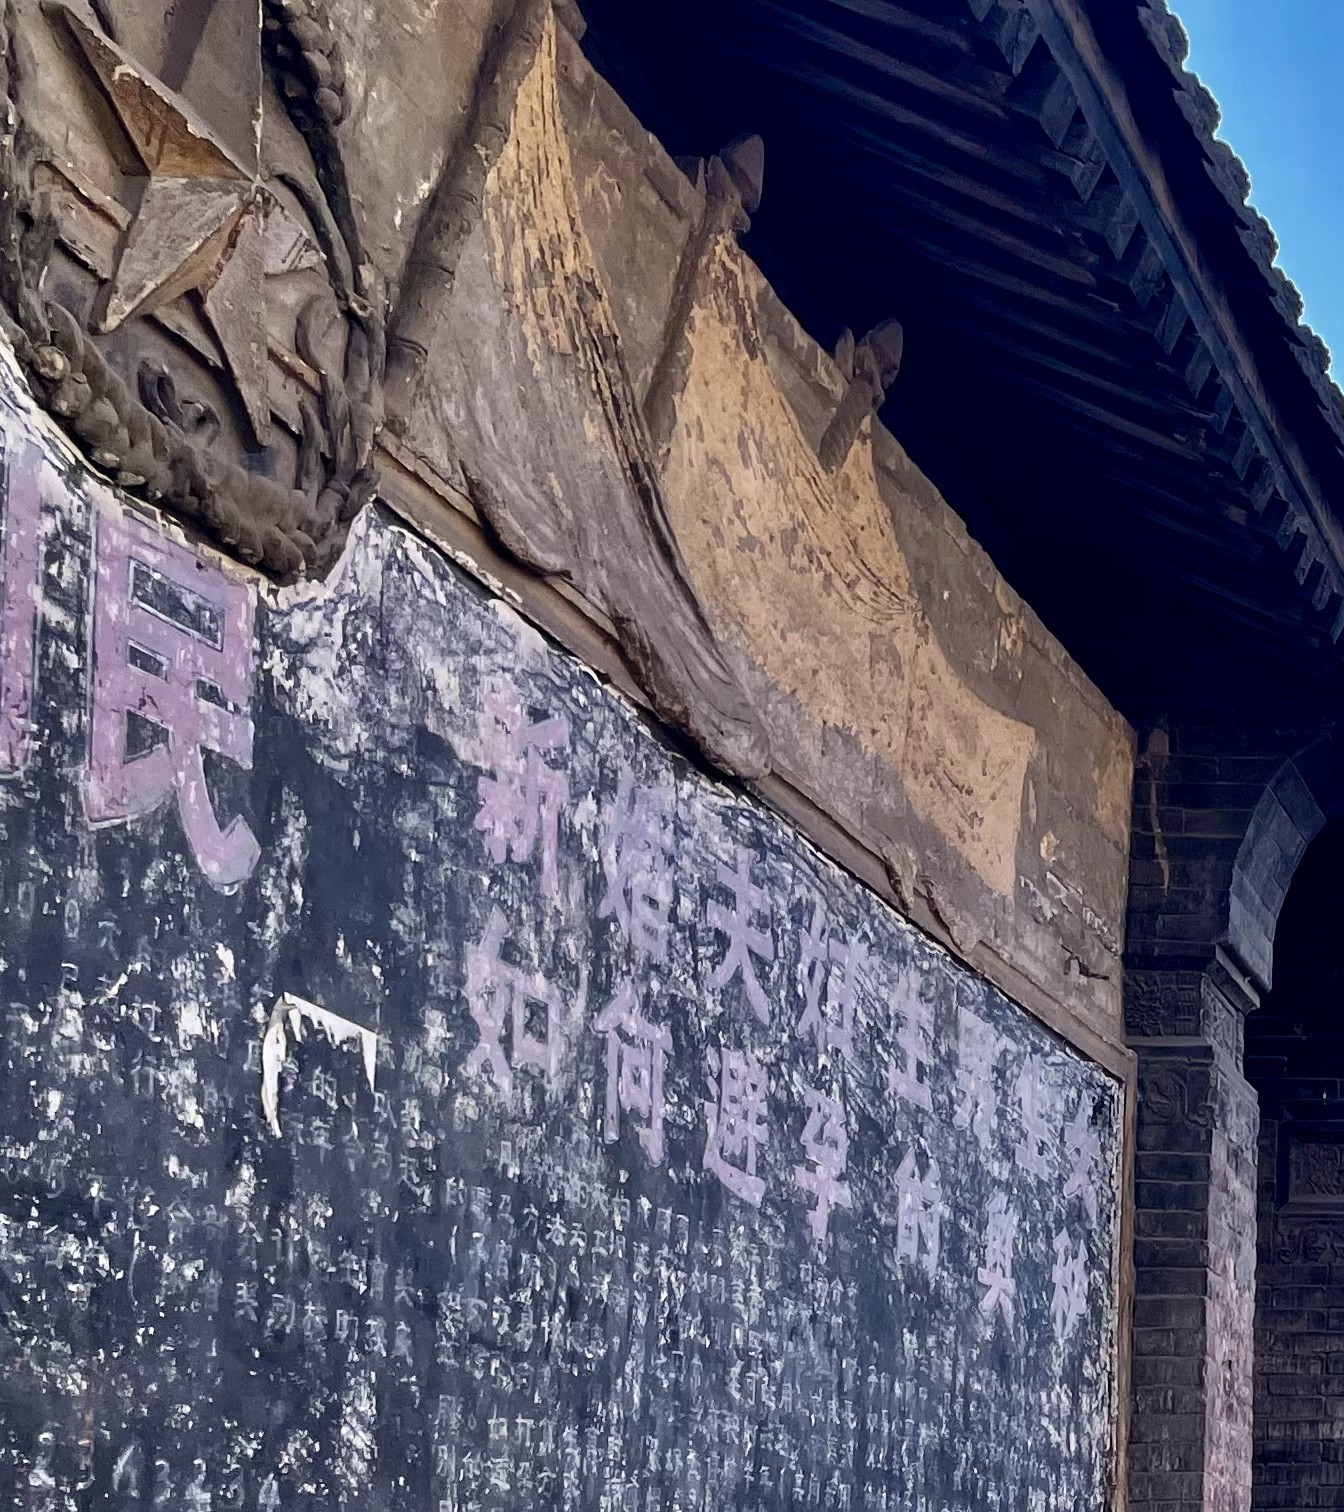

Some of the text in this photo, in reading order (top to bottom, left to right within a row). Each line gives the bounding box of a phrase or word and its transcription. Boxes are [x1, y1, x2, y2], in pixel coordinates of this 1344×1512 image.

[475, 680, 862, 1064] 新婚夫妇
[462, 906, 850, 1242] 如何避孕
